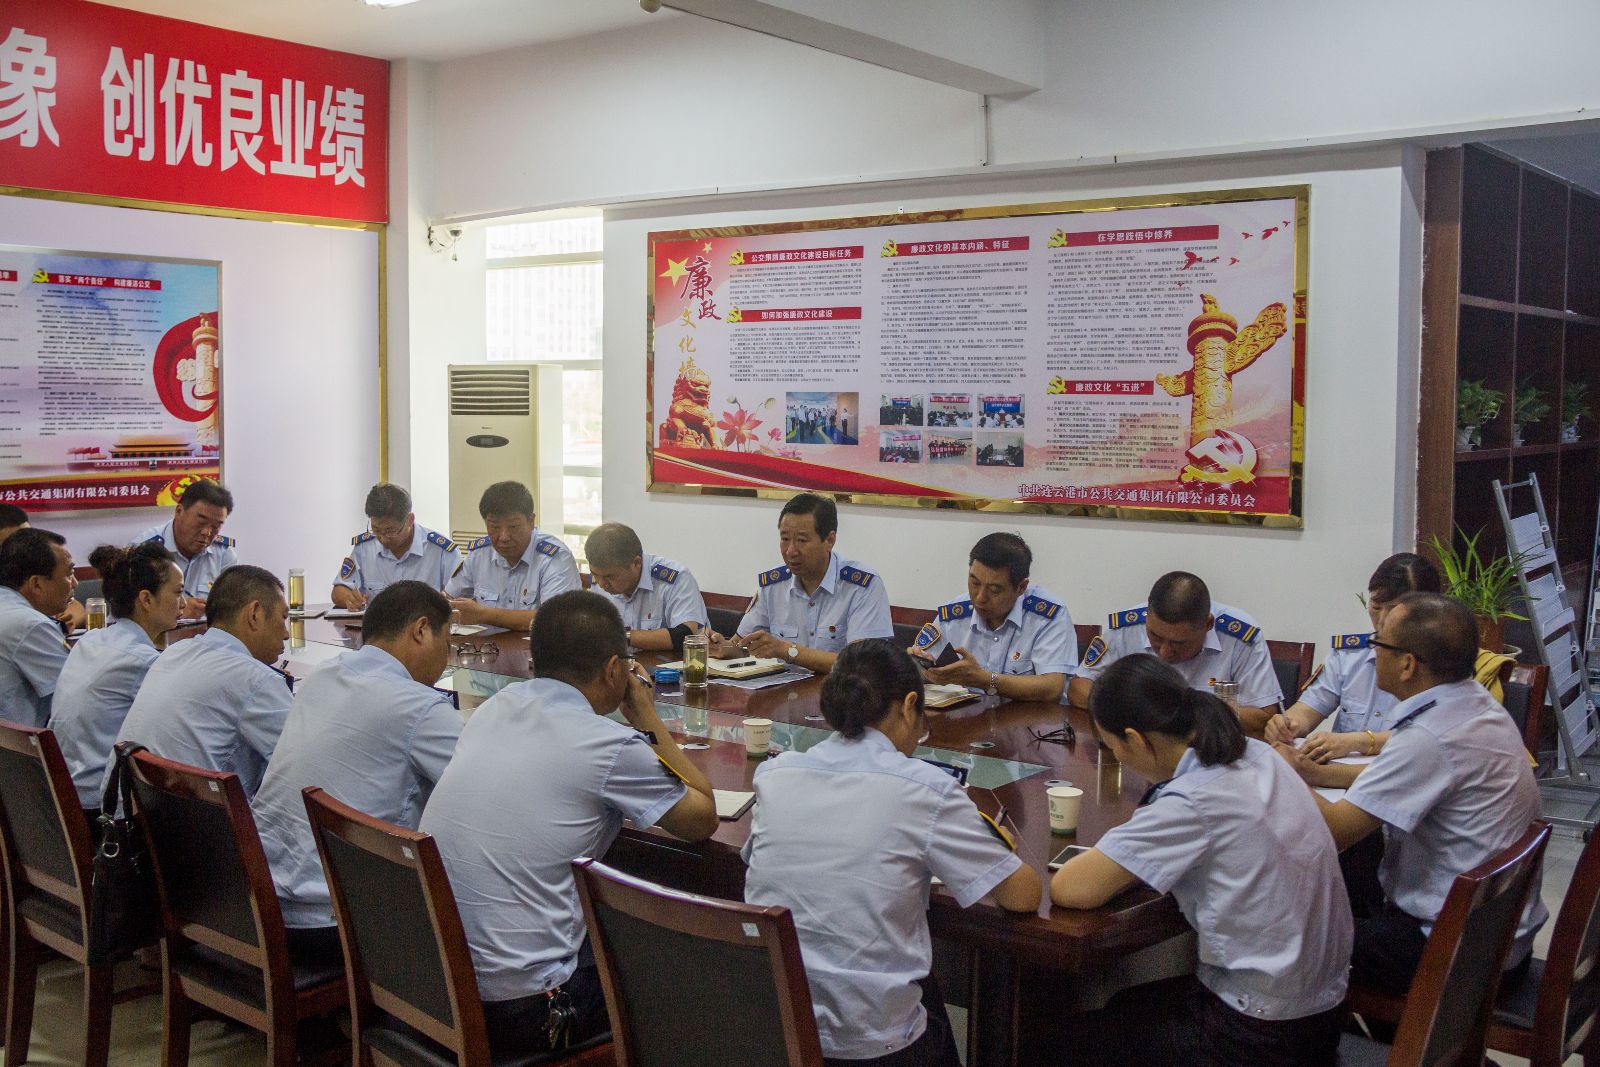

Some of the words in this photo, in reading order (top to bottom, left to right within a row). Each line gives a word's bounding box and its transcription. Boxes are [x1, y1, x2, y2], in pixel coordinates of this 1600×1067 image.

[0, 27, 60, 148] 象
[101, 46, 365, 188] 创优良业绩
[1097, 228, 1173, 243] 在学思践悟中修养
[911, 240, 1010, 254] 廉政文化的基本内涵、特征
[751, 249, 852, 262] 公交集团廉政文化建设目标任务
[680, 255, 722, 320] 廉政
[761, 309, 833, 320] 如何加强廉政文化建设
[1018, 483, 1256, 508] 中共连云港市公共交通集团有限公司委员会
